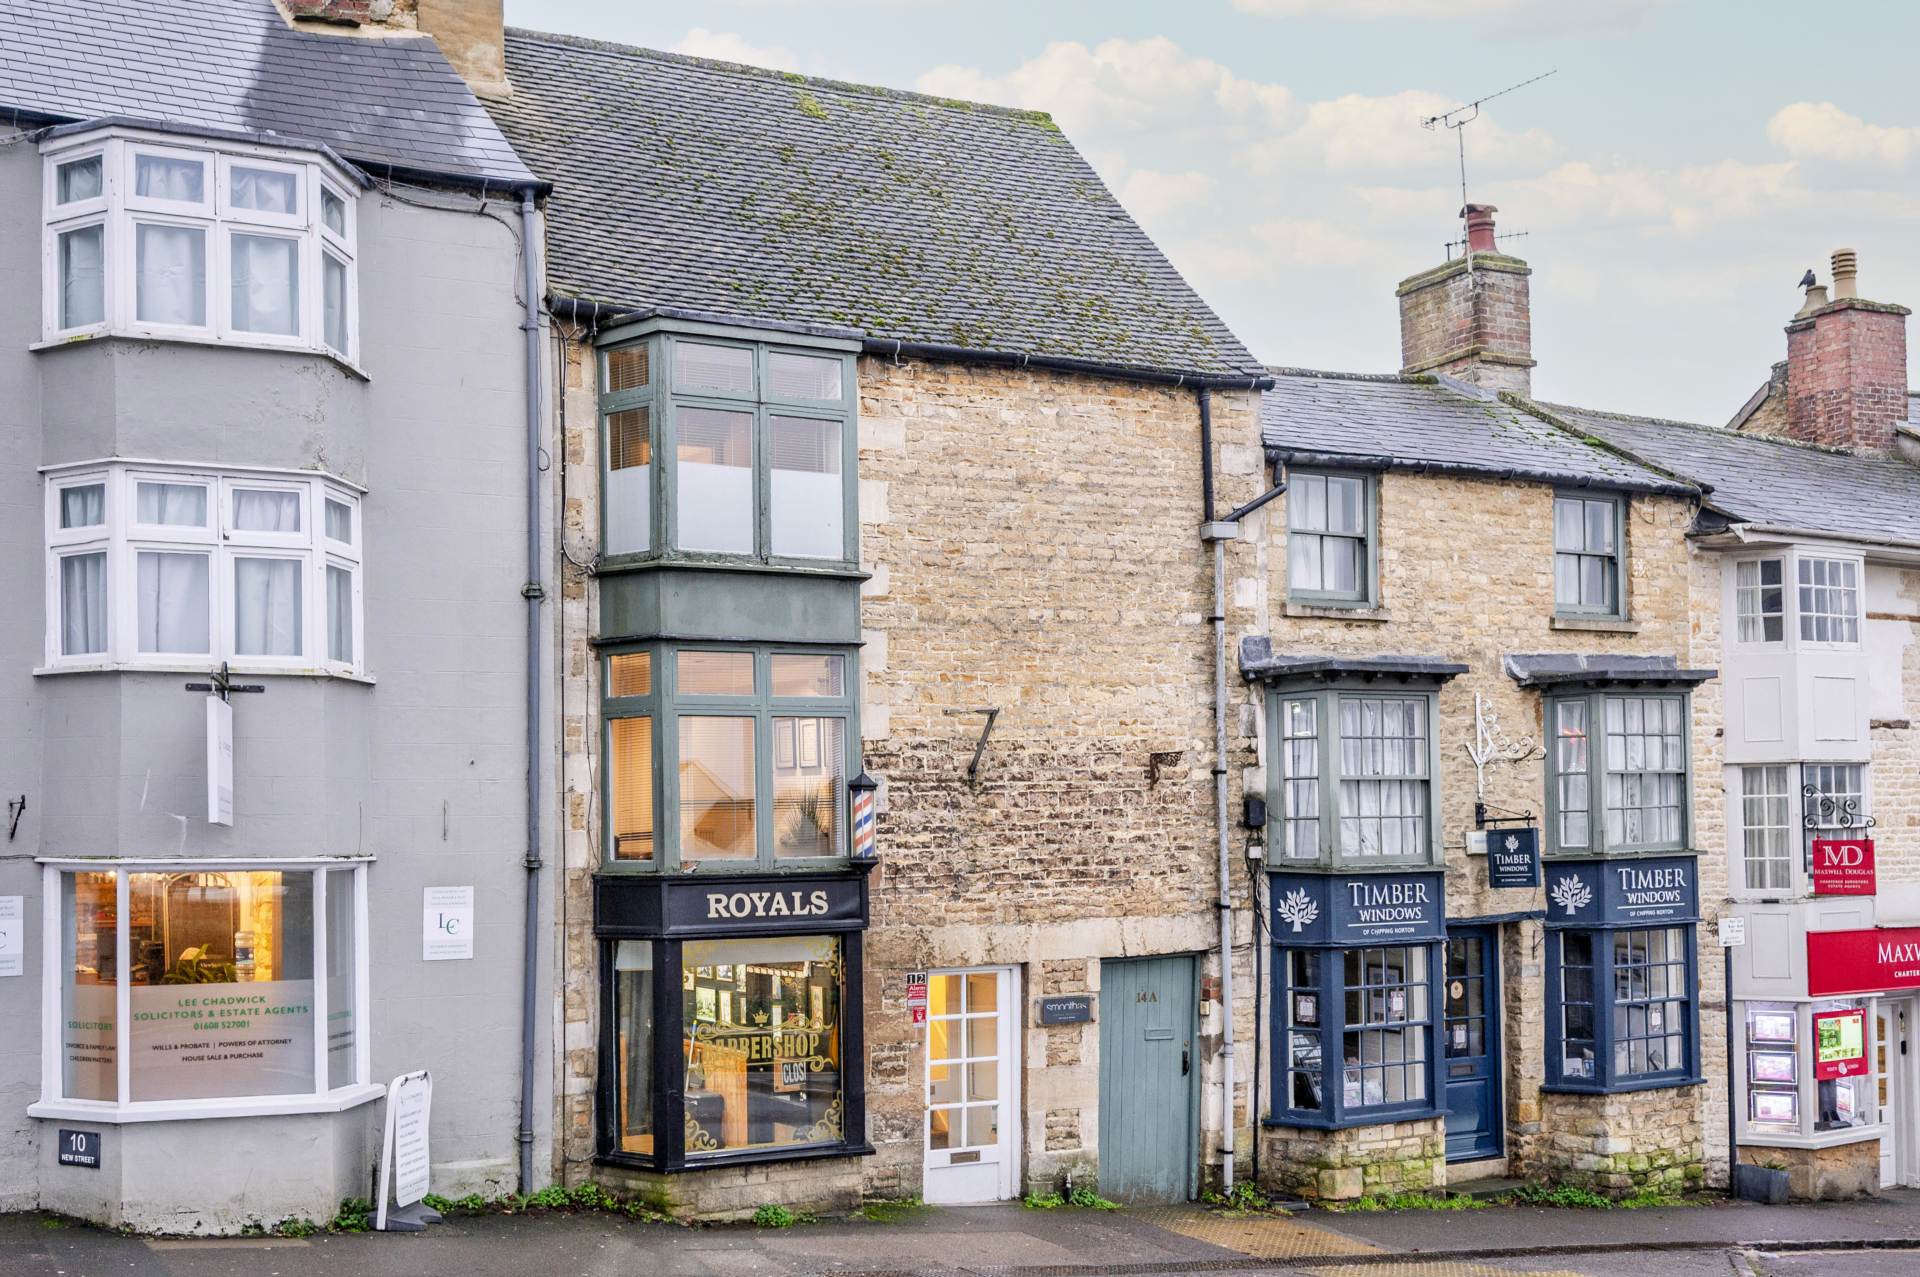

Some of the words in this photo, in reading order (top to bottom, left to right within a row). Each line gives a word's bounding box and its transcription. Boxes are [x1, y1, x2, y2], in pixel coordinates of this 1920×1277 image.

[1494, 853, 1532, 865] TIMBER
[1823, 845, 1863, 866] MD
[1617, 867, 1687, 890] TIMBER
[1348, 882, 1430, 907] TIMBER
[1626, 890, 1681, 904] WINDOWS
[706, 890, 829, 919] ROYALS
[1359, 906, 1422, 922] WINDOWS
[178, 998, 198, 1007] LEE
[202, 996, 267, 1007] CHADWICK
[1136, 992, 1158, 1003] 14A
[134, 1011, 204, 1021] SOLICITORS
[208, 1010, 215, 1018] &
[220, 1007, 261, 1017] ESTATE
[264, 1005, 309, 1015] AGENTS
[68, 1021, 112, 1031] SOLICITORS
[221, 1020, 250, 1030] 527001
[180, 1042, 210, 1050] PROBATE
[218, 1040, 246, 1048] POWERS
[257, 1038, 292, 1046] ATTORNEY
[229, 1052, 264, 1060] PURCHASE
[70, 1133, 86, 1152] 10
[61, 1153, 74, 1162] NEW
[74, 1154, 95, 1164] STREET
